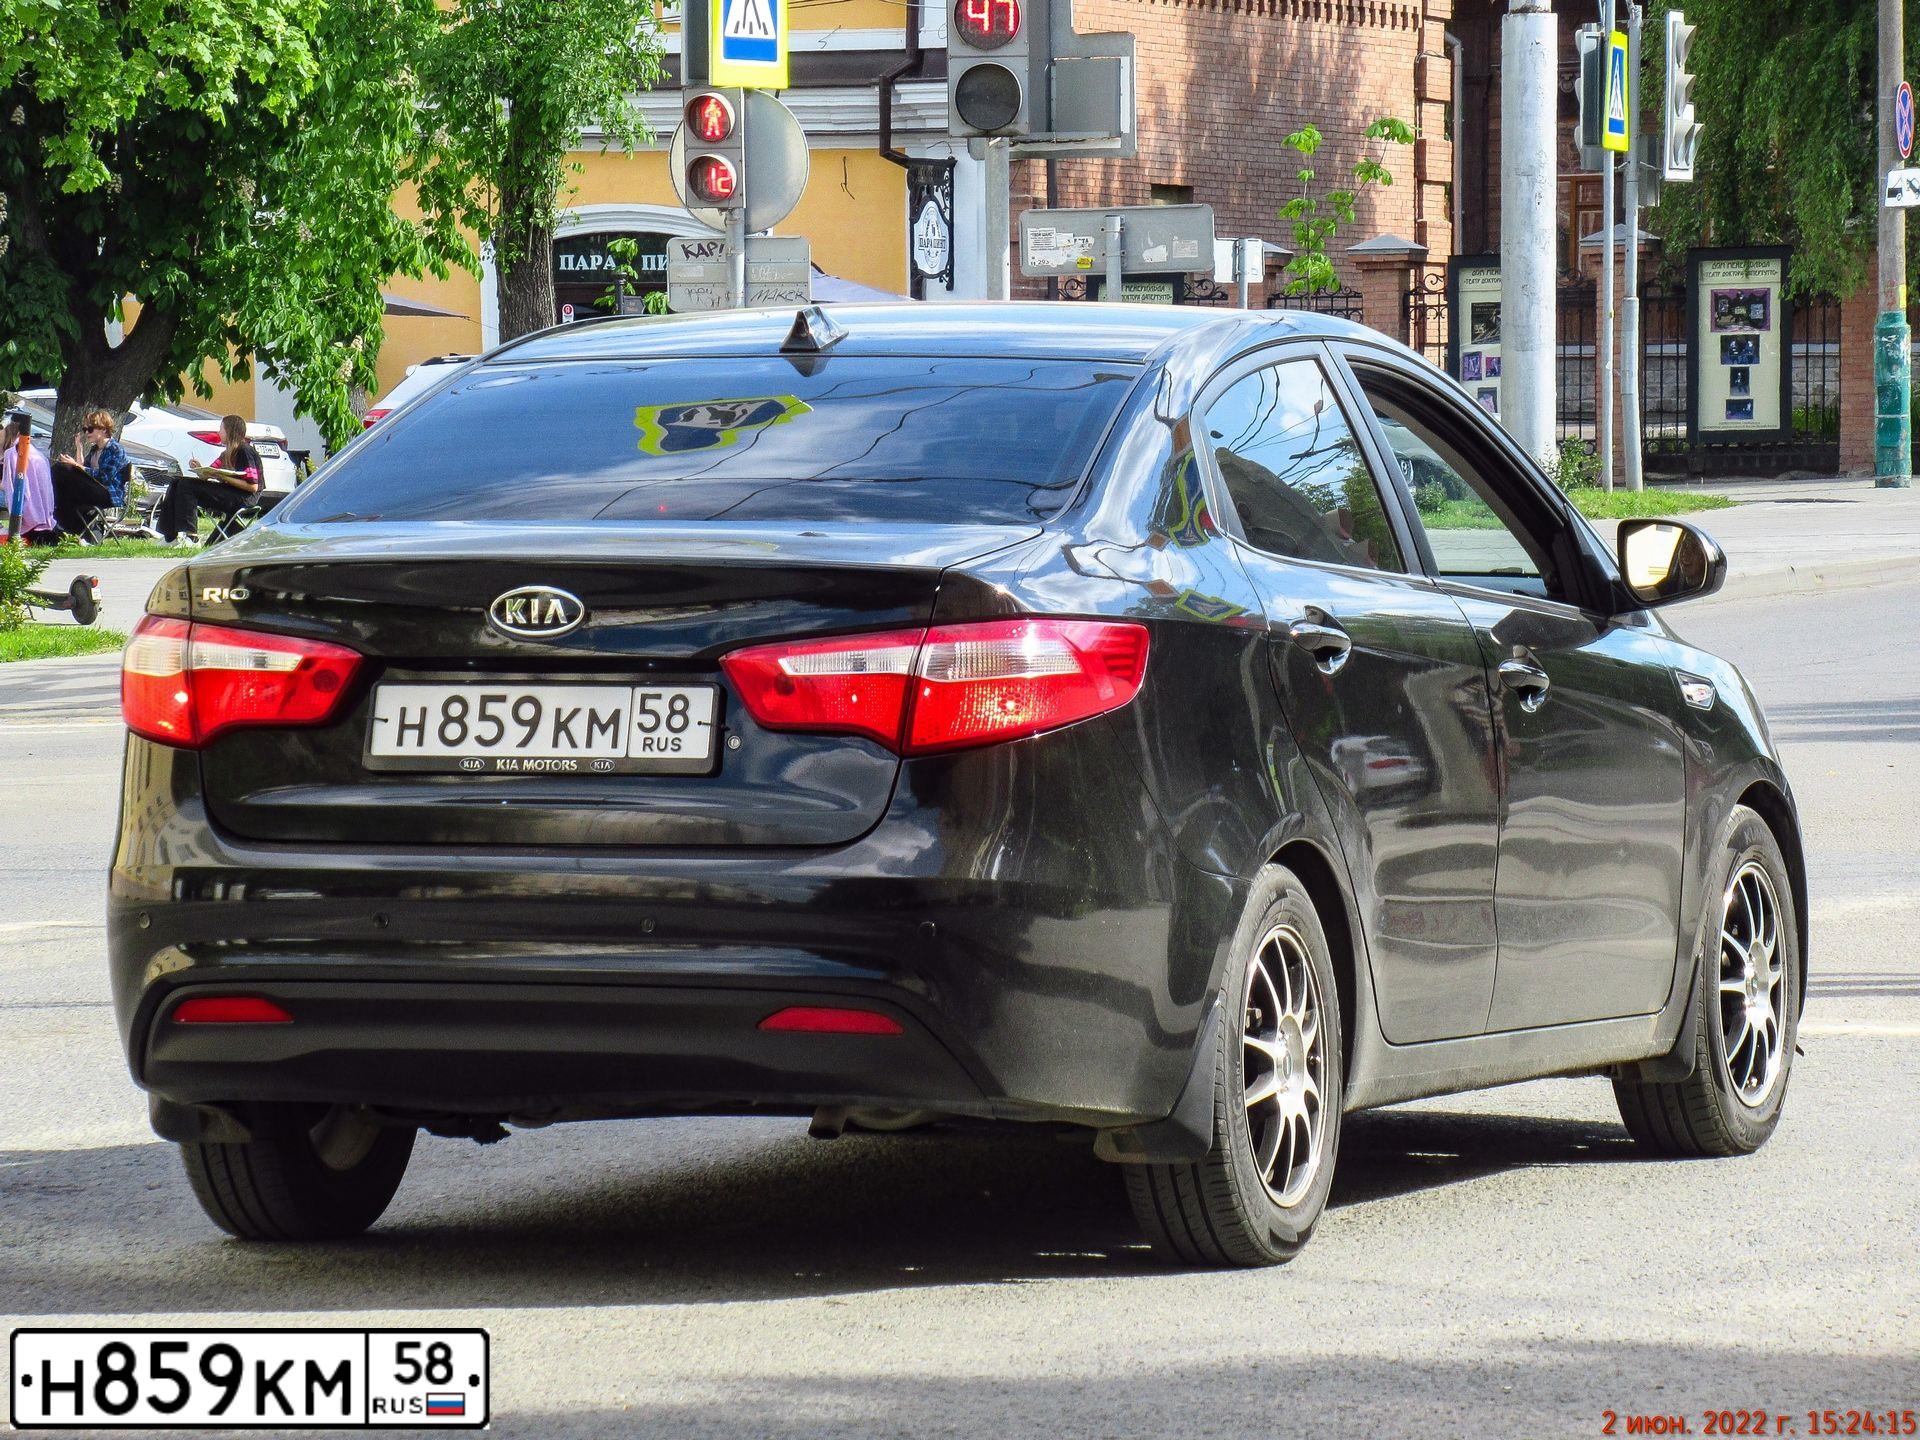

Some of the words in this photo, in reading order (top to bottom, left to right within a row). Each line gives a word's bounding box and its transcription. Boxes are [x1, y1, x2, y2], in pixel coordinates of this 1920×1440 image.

[967, 0, 1015, 32] 47
[711, 165, 732, 193] 12
[559, 254, 616, 271] ПАРА
[641, 254, 668, 271] ПИ
[202, 587, 250, 602] RIO
[505, 598, 568, 624] KIA
[637, 693, 690, 734] 58
[642, 737, 682, 752] RUS
[463, 760, 481, 769] KIA
[496, 759, 519, 771] KIA
[522, 760, 578, 771] MOTORS
[593, 760, 613, 770] KIA
